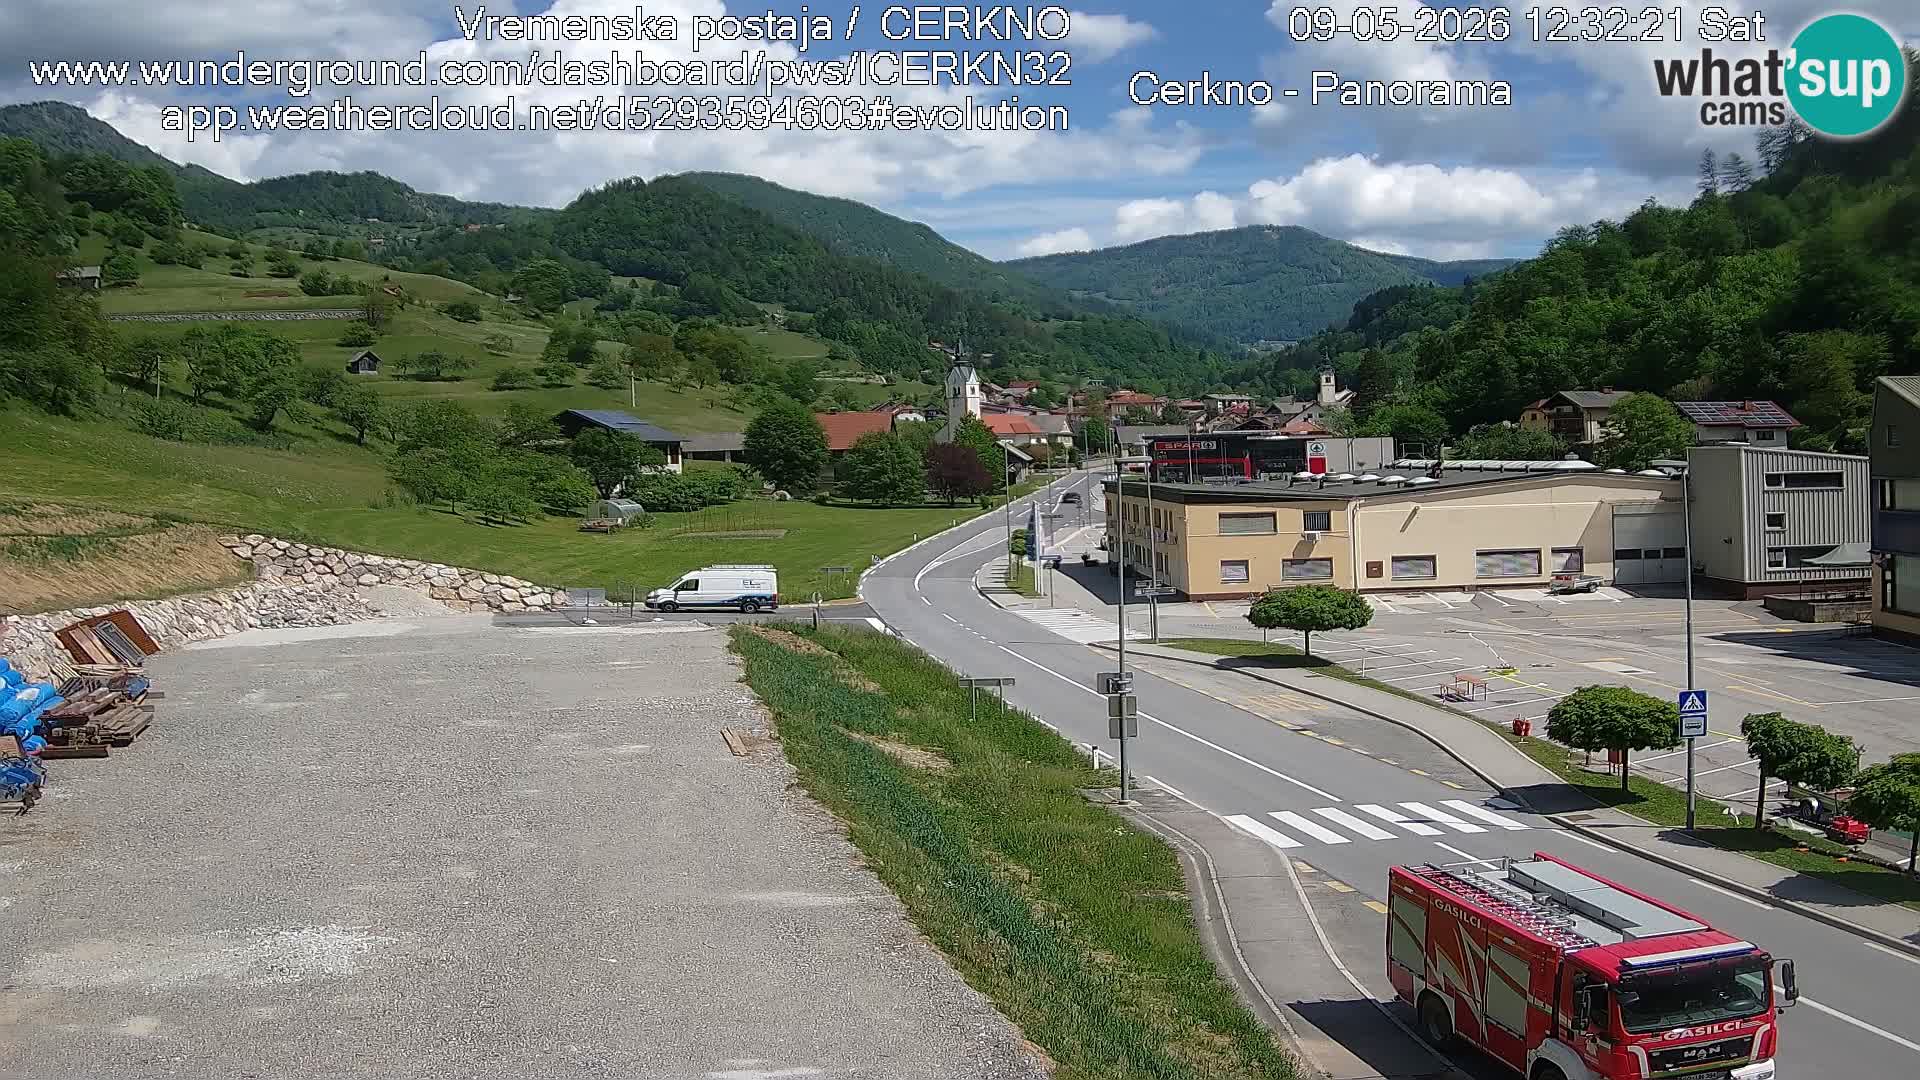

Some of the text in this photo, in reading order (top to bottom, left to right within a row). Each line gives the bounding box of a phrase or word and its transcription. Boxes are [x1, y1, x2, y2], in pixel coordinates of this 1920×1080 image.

[1434, 899, 1481, 929] GASILCI
[1663, 1020, 1741, 1041] GASILCI
[1683, 1045, 1720, 1058] MAN
